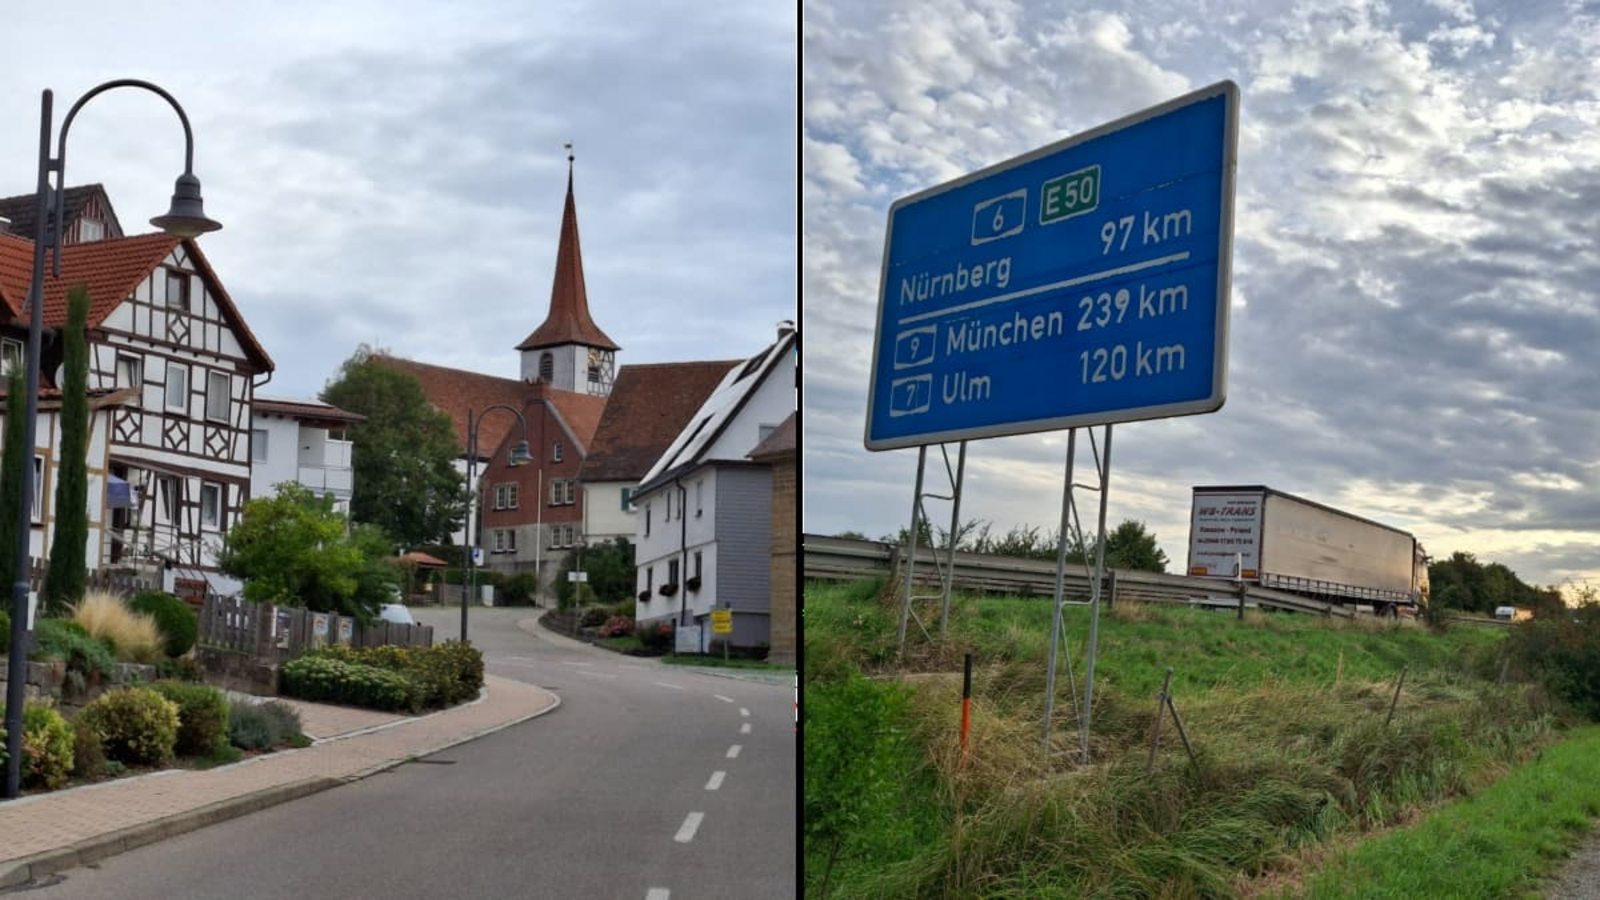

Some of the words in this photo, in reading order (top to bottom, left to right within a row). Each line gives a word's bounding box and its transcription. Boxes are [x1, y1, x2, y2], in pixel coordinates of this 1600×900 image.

[992, 205, 1004, 231] 6
[1101, 215, 1135, 255] 97
[1143, 209, 1191, 244] km
[900, 256, 1011, 305] Nürnberg
[946, 311, 1063, 356] München
[1077, 289, 1129, 331] 239
[1139, 284, 1188, 319] km
[911, 337, 920, 359] 9
[906, 383, 917, 406] 7
[943, 372, 990, 404] Ulm
[1080, 346, 1127, 385] 120
[1136, 341, 1185, 375] km
